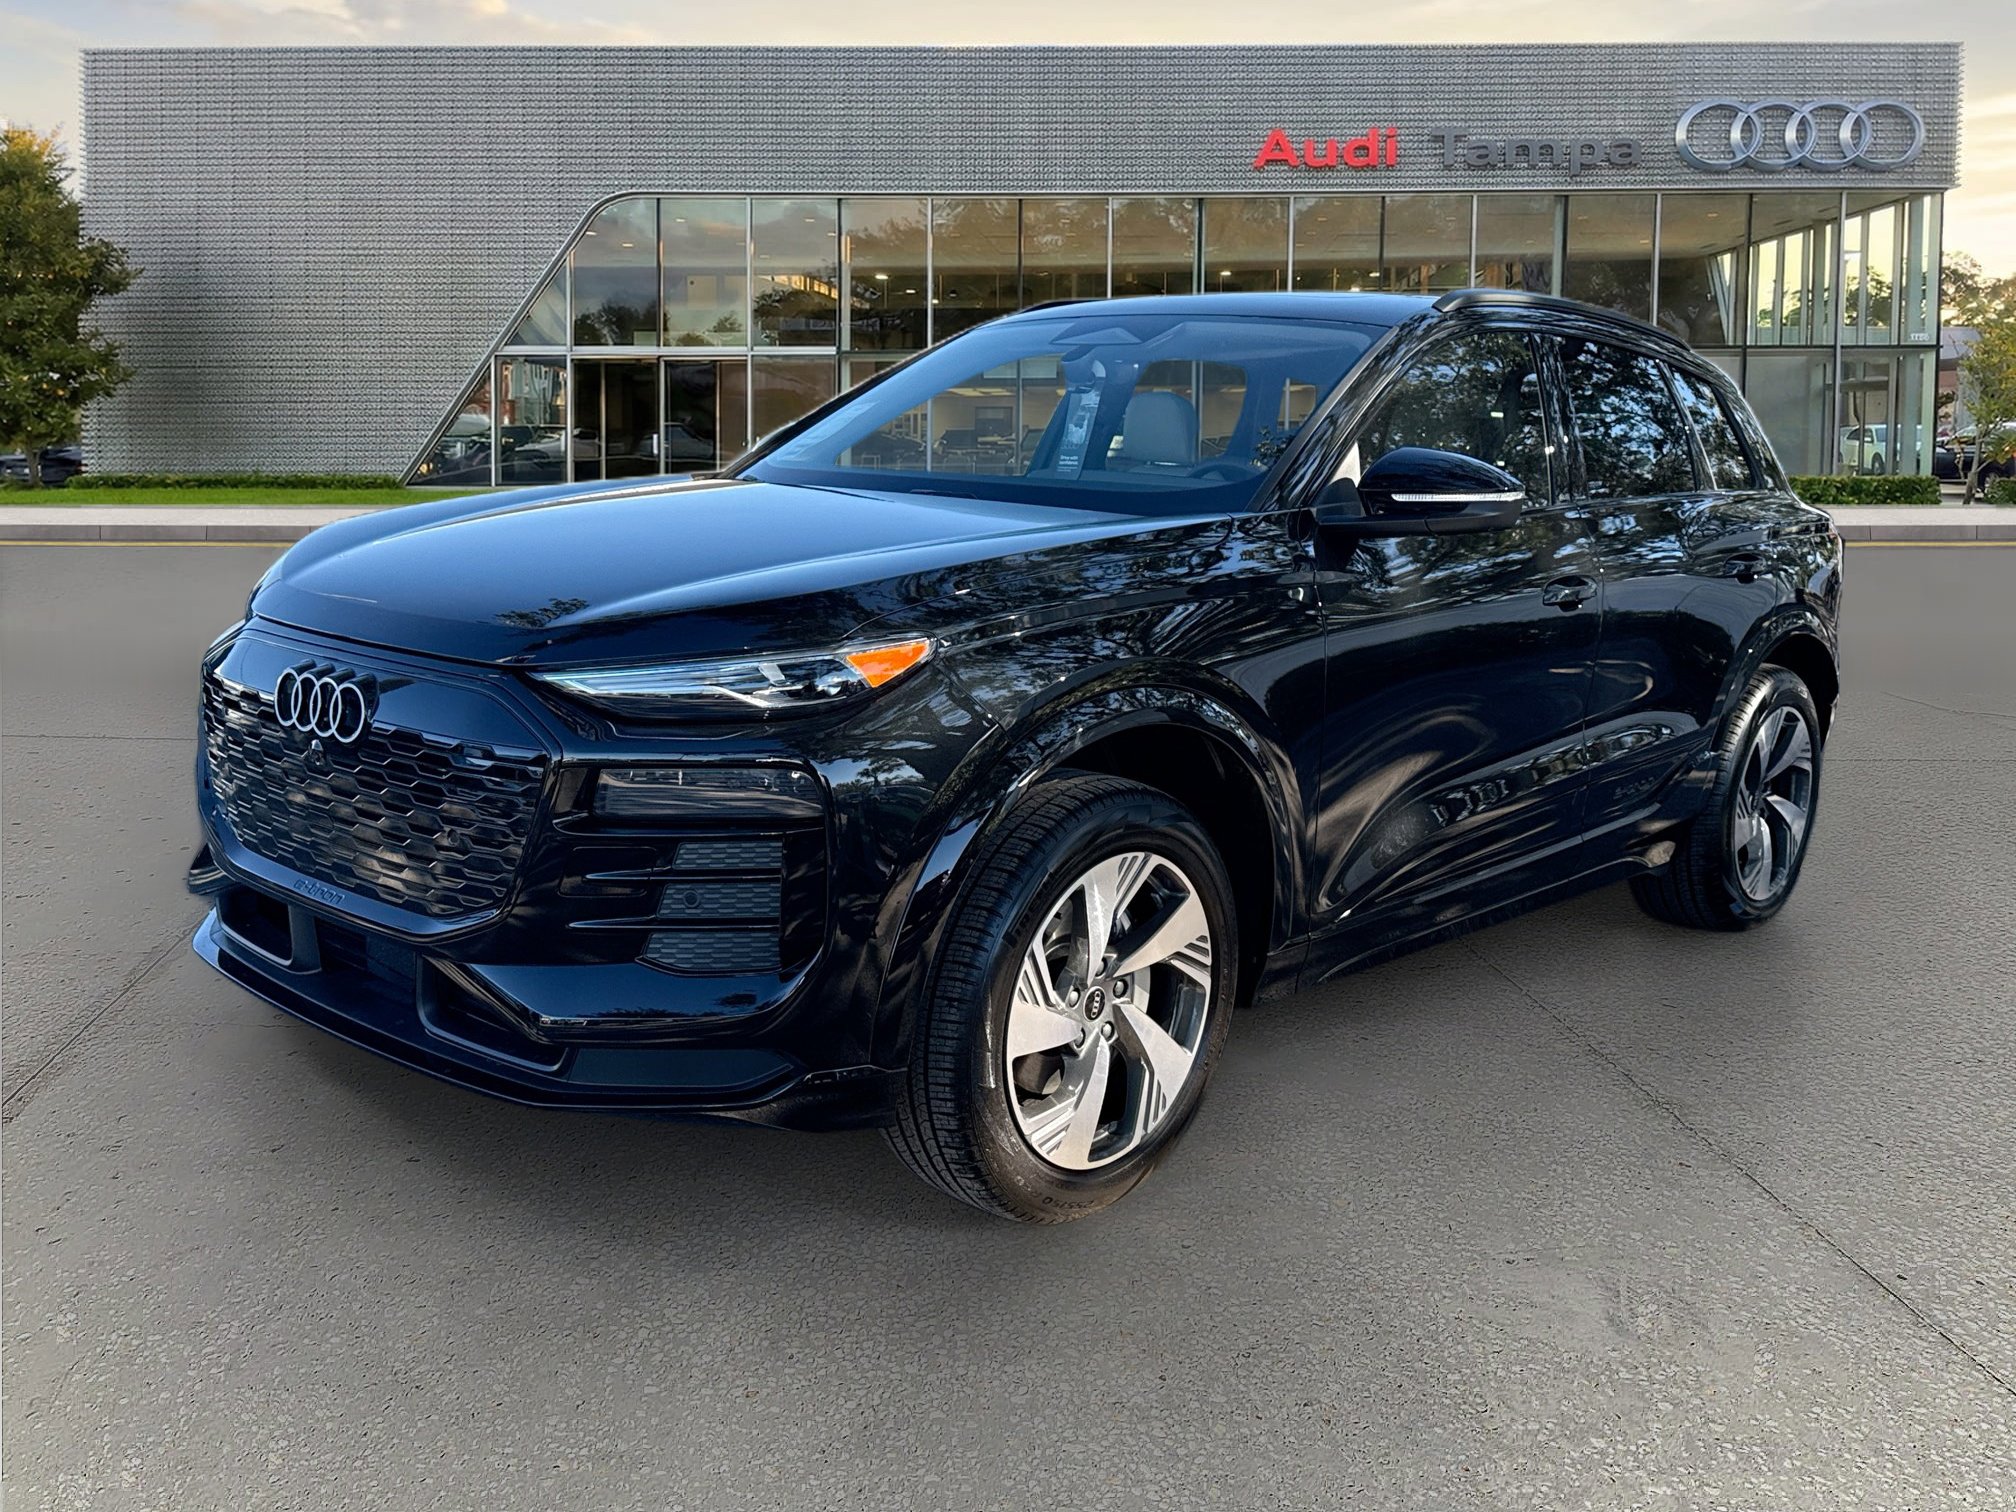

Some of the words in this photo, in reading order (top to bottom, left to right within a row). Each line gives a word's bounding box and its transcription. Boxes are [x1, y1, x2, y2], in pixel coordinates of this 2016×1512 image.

[1253, 127, 1398, 170] Audi
[1431, 126, 1642, 178] Tampa
[295, 879, 345, 904] e-tron
